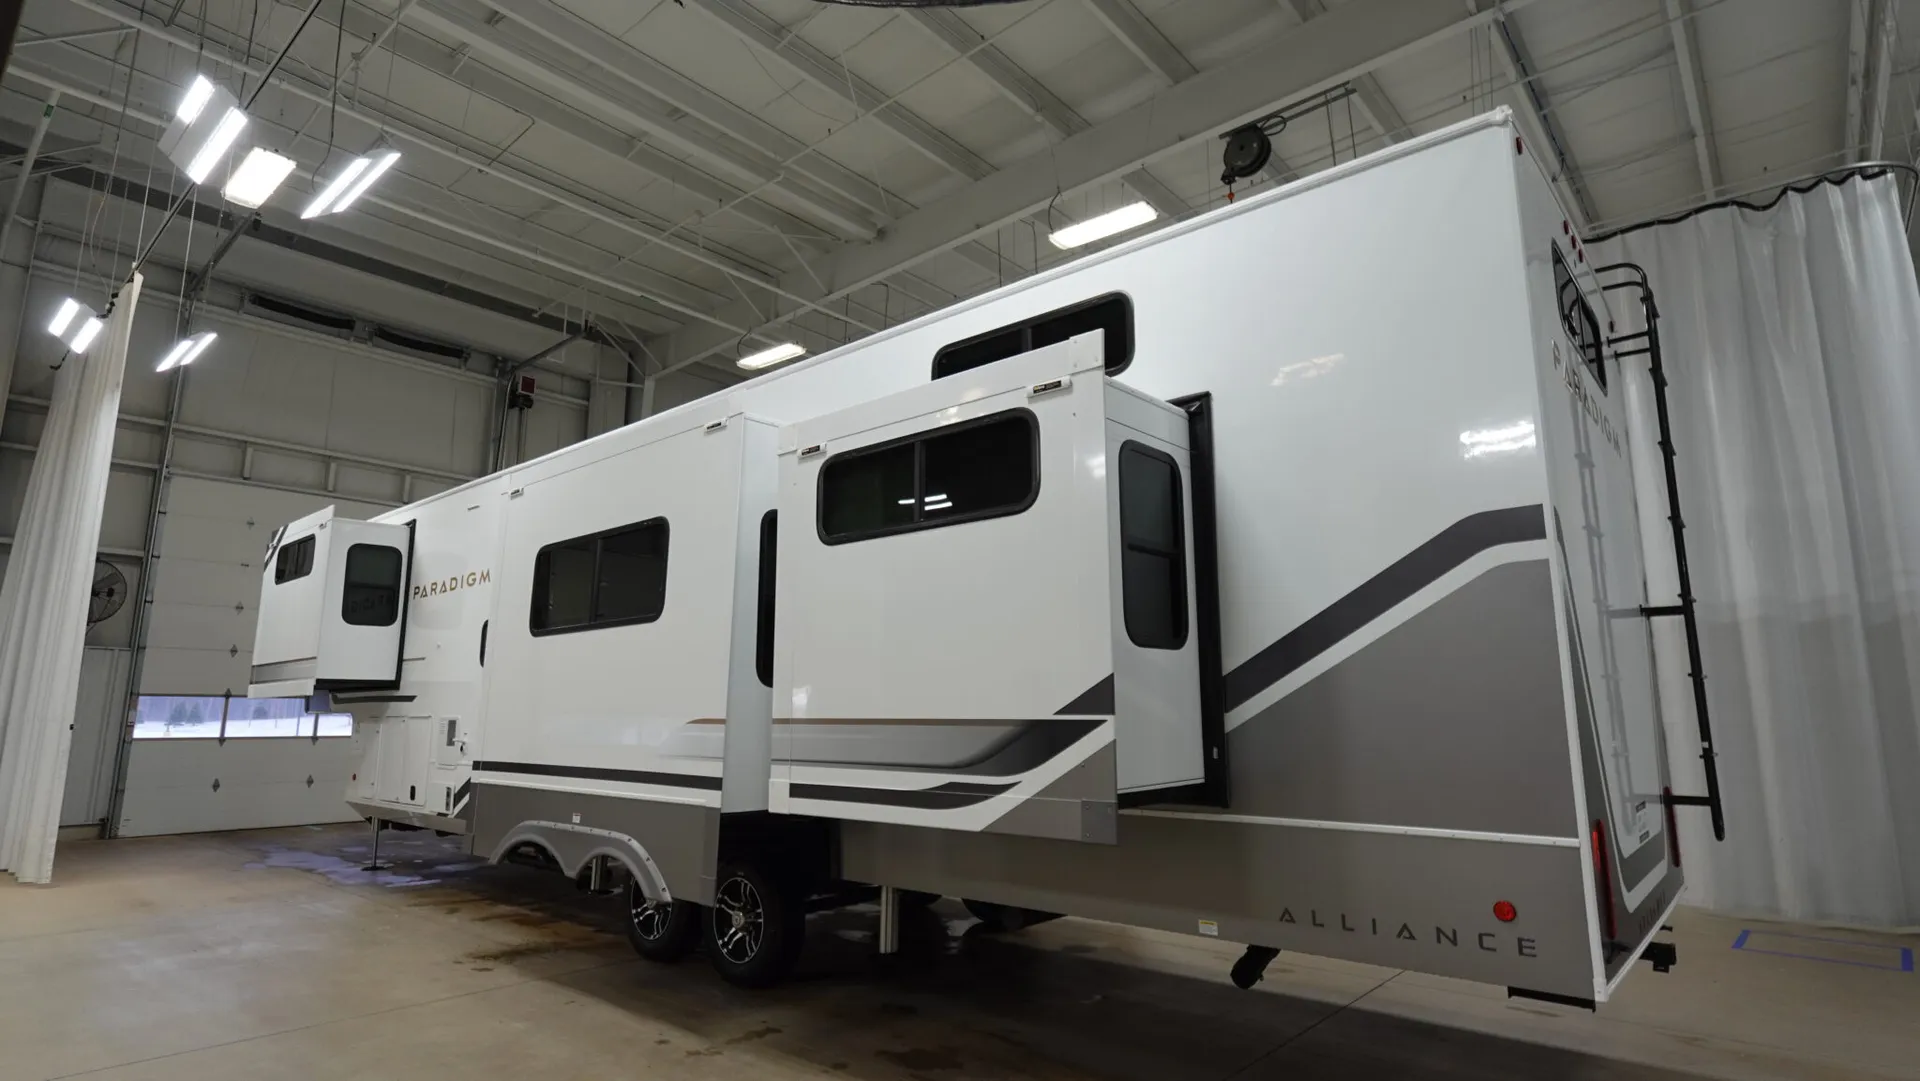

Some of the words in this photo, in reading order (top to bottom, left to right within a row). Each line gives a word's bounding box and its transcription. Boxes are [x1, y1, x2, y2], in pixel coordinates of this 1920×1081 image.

[1551, 338, 1622, 459] PARADIGM
[413, 568, 491, 600] PARADIGM
[1279, 907, 1537, 958] ALLIANCE
